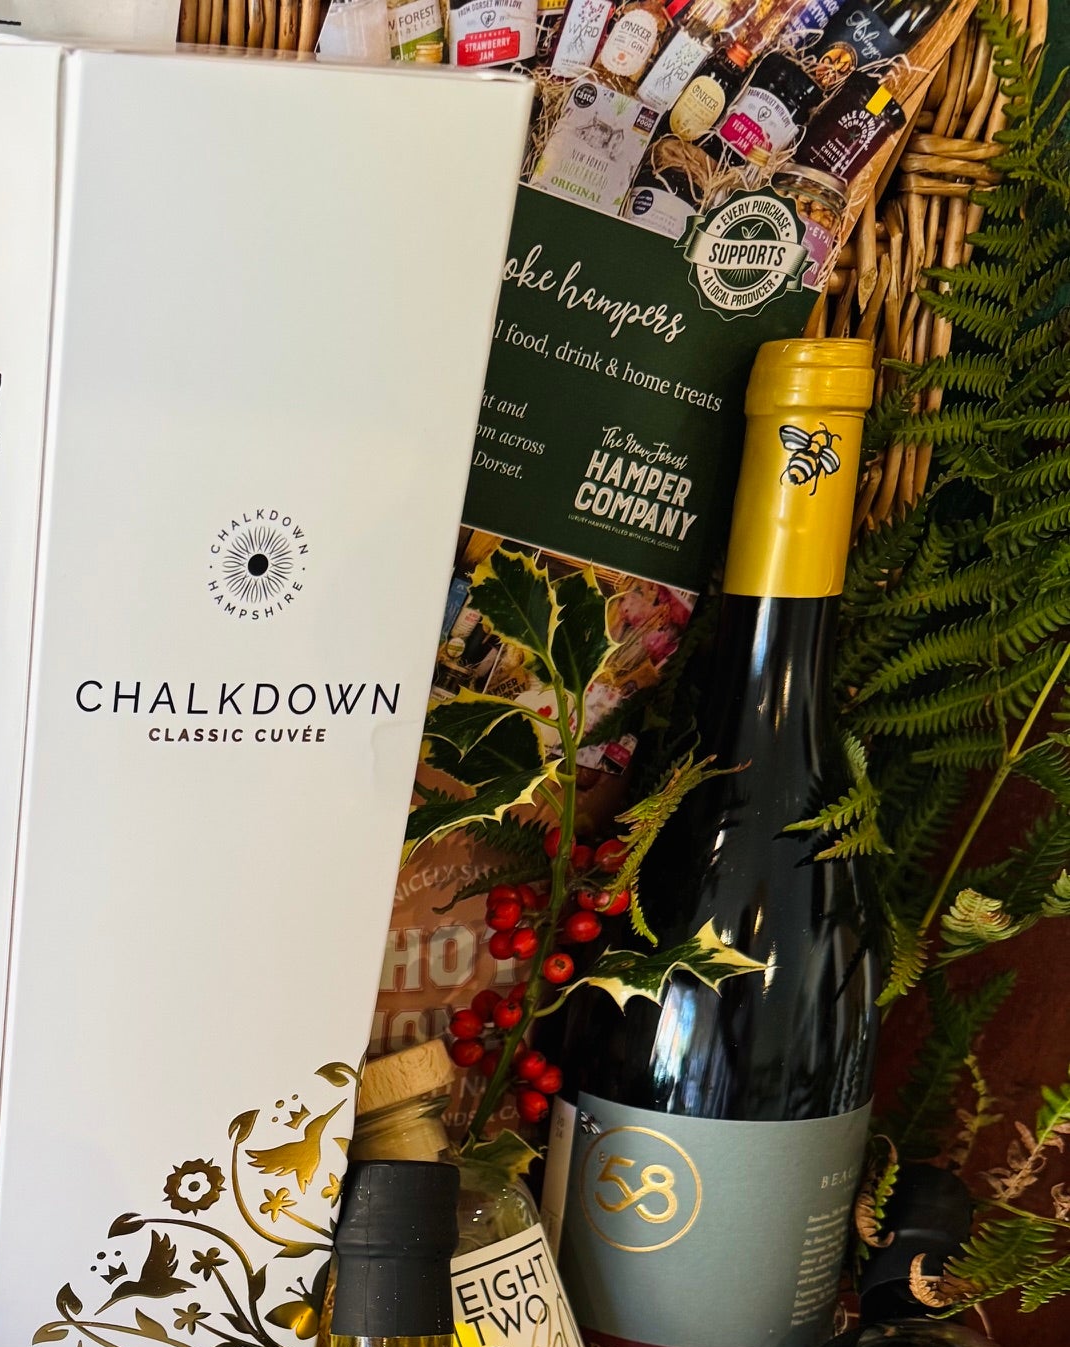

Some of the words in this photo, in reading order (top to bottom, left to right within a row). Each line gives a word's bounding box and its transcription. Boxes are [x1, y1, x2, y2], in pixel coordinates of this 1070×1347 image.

[399, 4, 436, 28] FOREST
[464, 37, 511, 53] STRAWBERRY
[479, 51, 495, 62] JAM
[551, 176, 601, 203] ORIGINAL
[721, 204, 750, 225] EVERY
[752, 200, 791, 234] PURCHASE
[708, 242, 787, 267] SUPPORTS
[557, 261, 686, 343] hampers
[706, 281, 730, 305] LOCAL
[731, 279, 776, 306] PRODUCER
[507, 324, 550, 359] food,
[555, 340, 600, 372] drink
[605, 358, 618, 378] &
[622, 361, 670, 395] home
[674, 381, 723, 413] treats
[497, 398, 528, 420] and
[498, 431, 546, 456] across
[602, 425, 624, 449] The
[473, 450, 524, 480] Dorset.
[584, 450, 692, 507] HAMPER
[574, 482, 698, 542] COMPANY
[210, 509, 309, 556] CHALKDOWN
[208, 580, 303, 620] HAMPSHIRE
[76, 679, 401, 715] CHALKDOWN
[148, 727, 243, 743] CLASSIC
[255, 724, 327, 743] CUVÉE
[594, 1154, 678, 1224] 58
[456, 1253, 548, 1316] EIGHT
[465, 1294, 547, 1346] TWO
